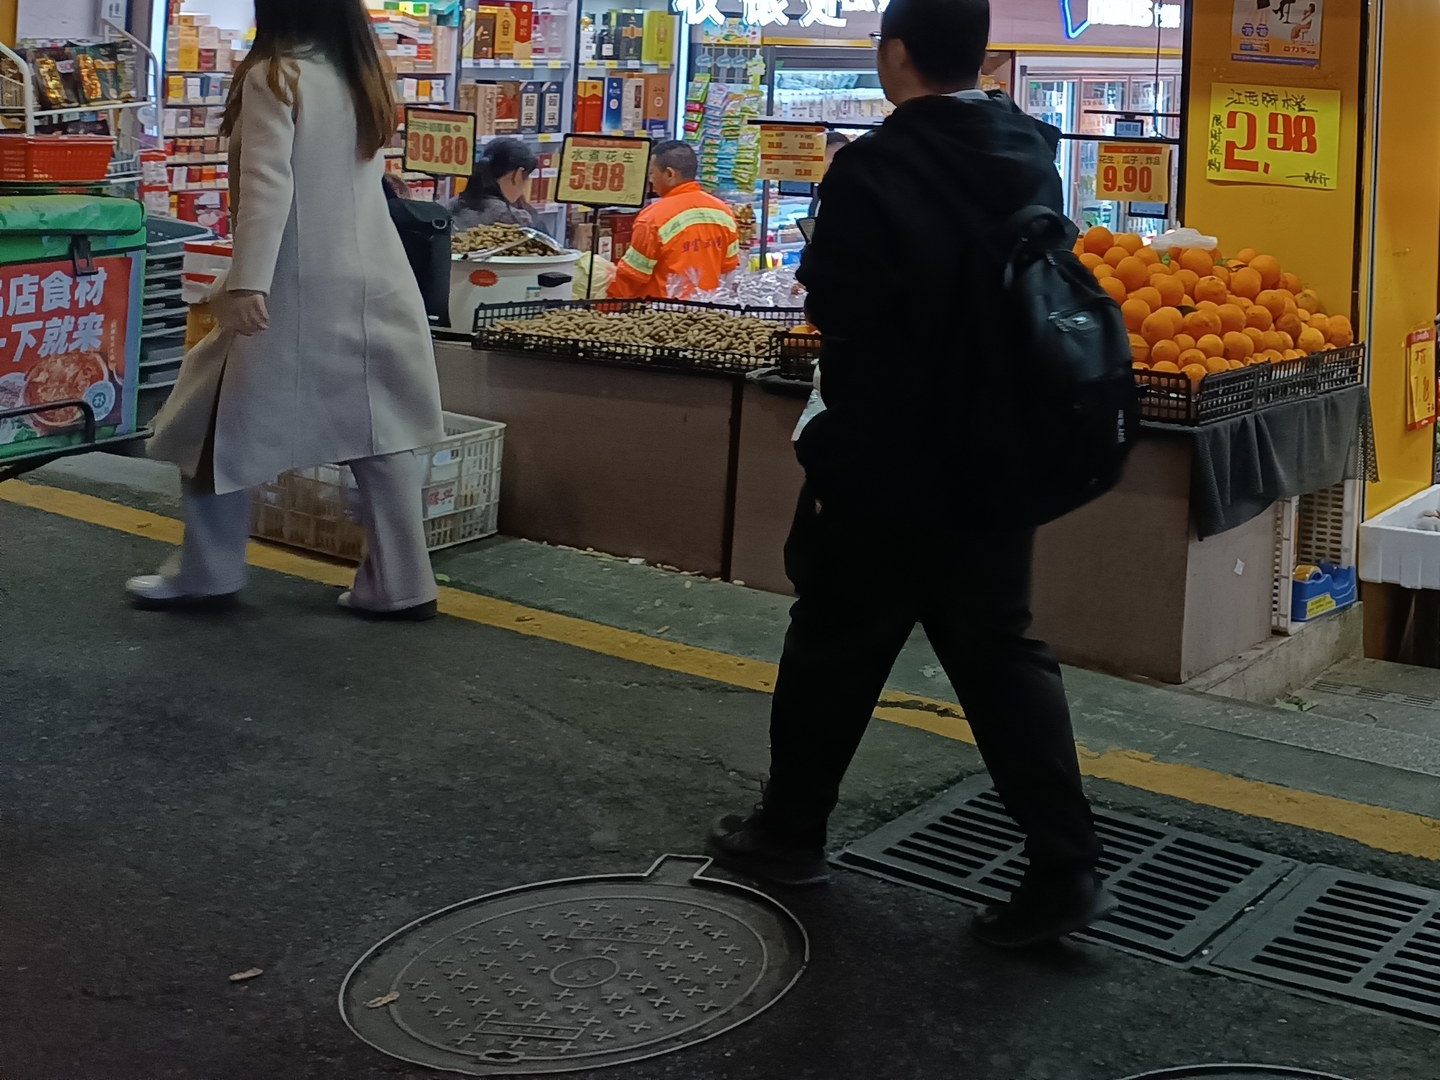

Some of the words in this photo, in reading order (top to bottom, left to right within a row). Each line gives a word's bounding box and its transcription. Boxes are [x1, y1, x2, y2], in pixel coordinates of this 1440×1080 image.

[408, 131, 469, 166] 39.80
[570, 148, 636, 164] 水煮花生
[568, 161, 626, 193] 5.98
[1102, 165, 1153, 193] 9.90
[0, 267, 108, 318] 店食材
